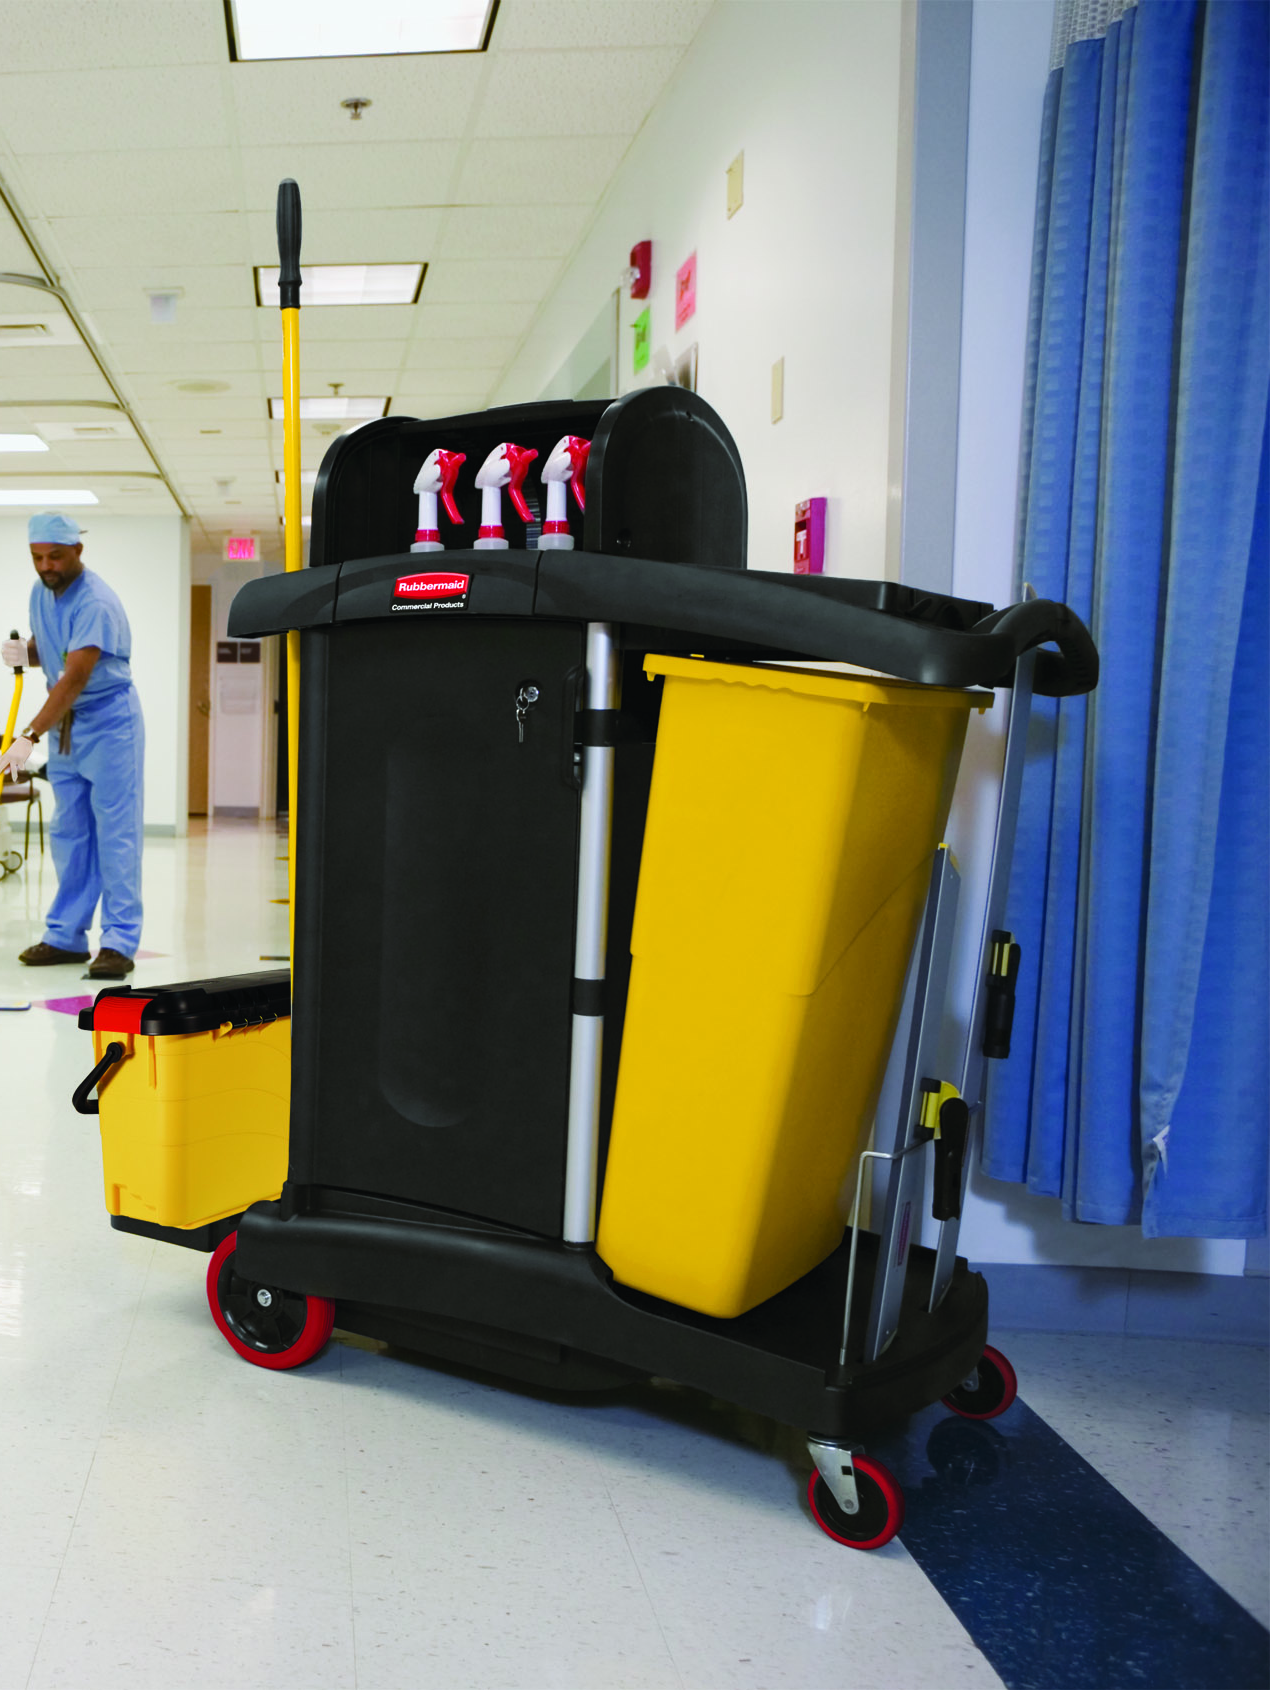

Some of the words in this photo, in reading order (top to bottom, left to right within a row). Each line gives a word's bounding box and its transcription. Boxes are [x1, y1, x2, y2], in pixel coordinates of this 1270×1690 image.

[398, 580, 465, 592] Rubbermaid
[391, 602, 432, 611] Commercial
[433, 601, 465, 609] Products
